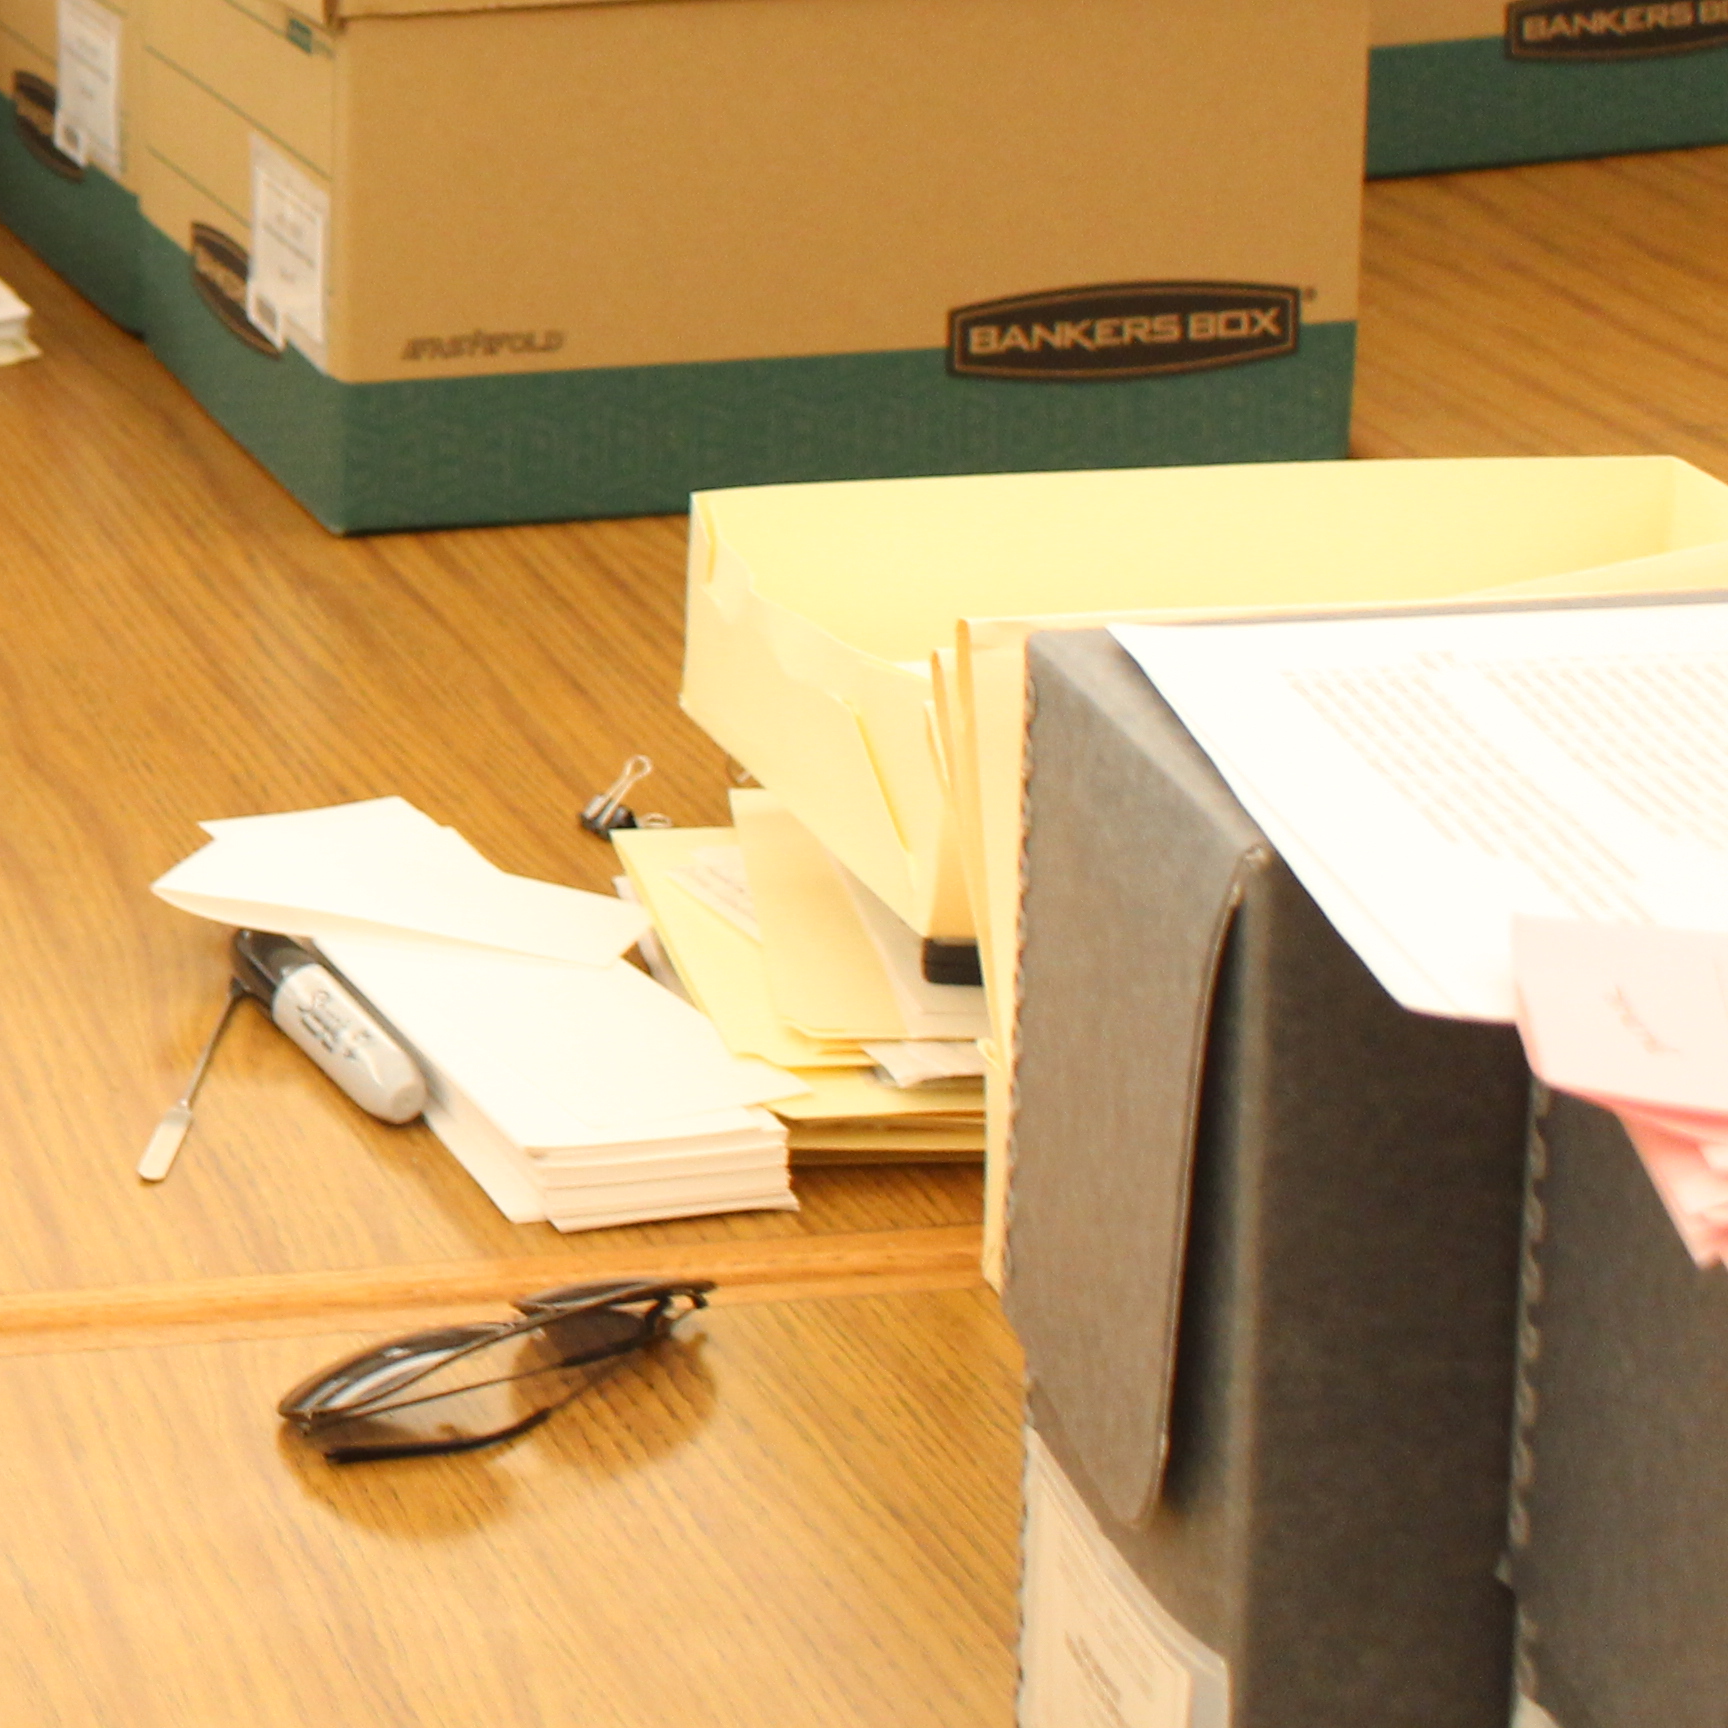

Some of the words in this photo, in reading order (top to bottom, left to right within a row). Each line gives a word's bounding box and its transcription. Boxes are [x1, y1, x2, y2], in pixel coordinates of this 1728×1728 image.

[1522, 0, 1694, 42] BANKERS
[967, 313, 1181, 356] BANKERS
[1187, 306, 1283, 343] BOX
